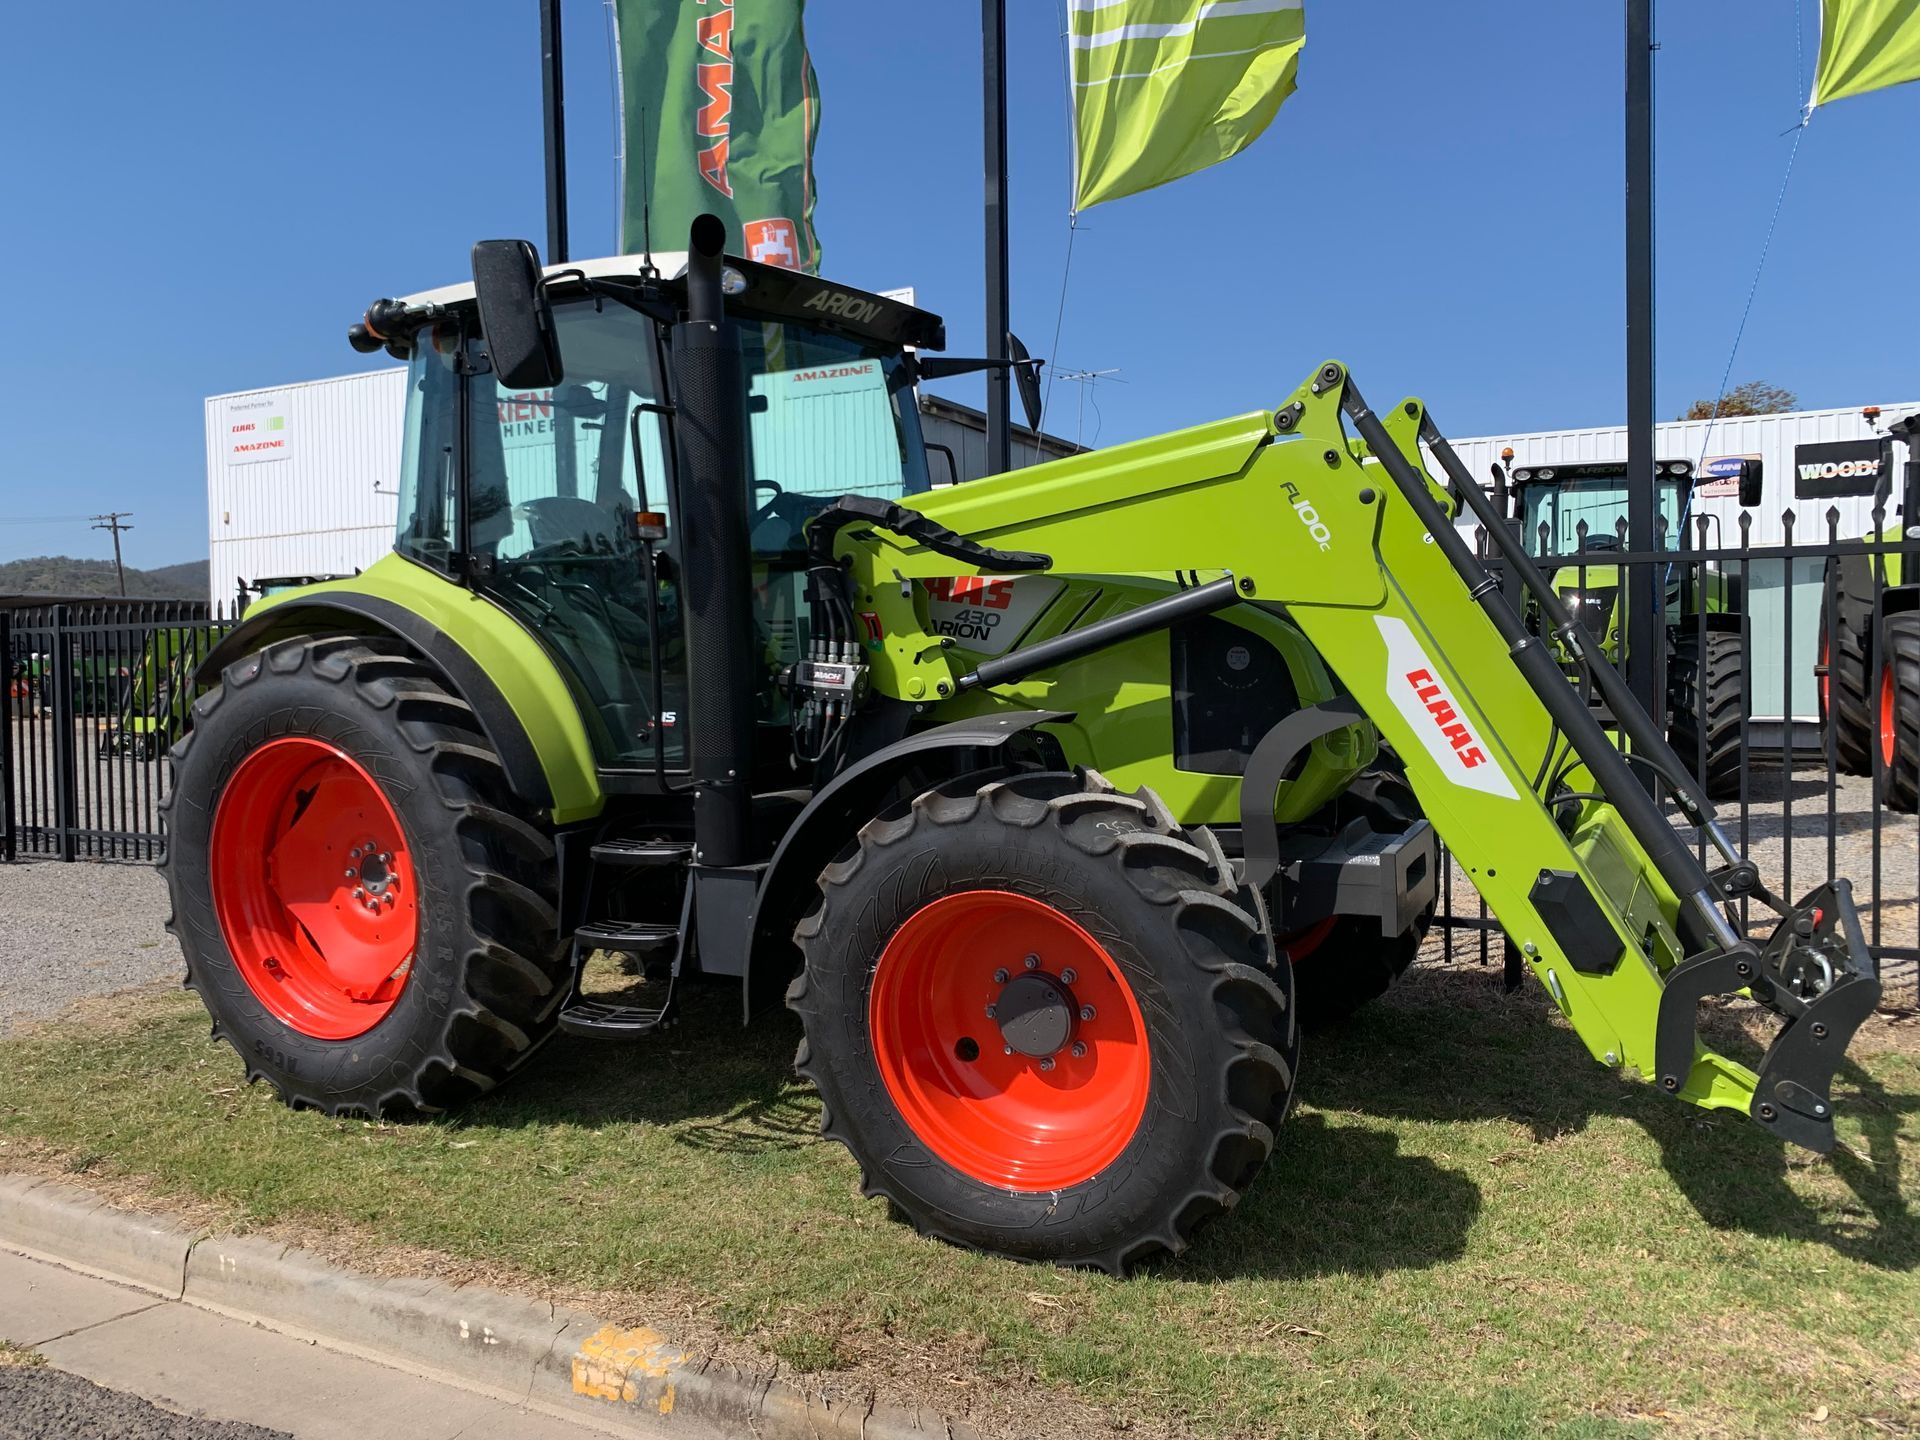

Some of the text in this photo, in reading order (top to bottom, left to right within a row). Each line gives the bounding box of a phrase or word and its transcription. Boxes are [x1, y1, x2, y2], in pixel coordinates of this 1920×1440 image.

[697, 0, 734, 200] AMA
[803, 289, 883, 324] ARION
[793, 364, 873, 382] AMAZONE
[232, 423, 256, 433] CLAAS
[233, 440, 285, 453] AMAZONE
[955, 609, 1001, 628] 430
[814, 671, 842, 680] MACH
[1406, 668, 1488, 769] CLAAS
